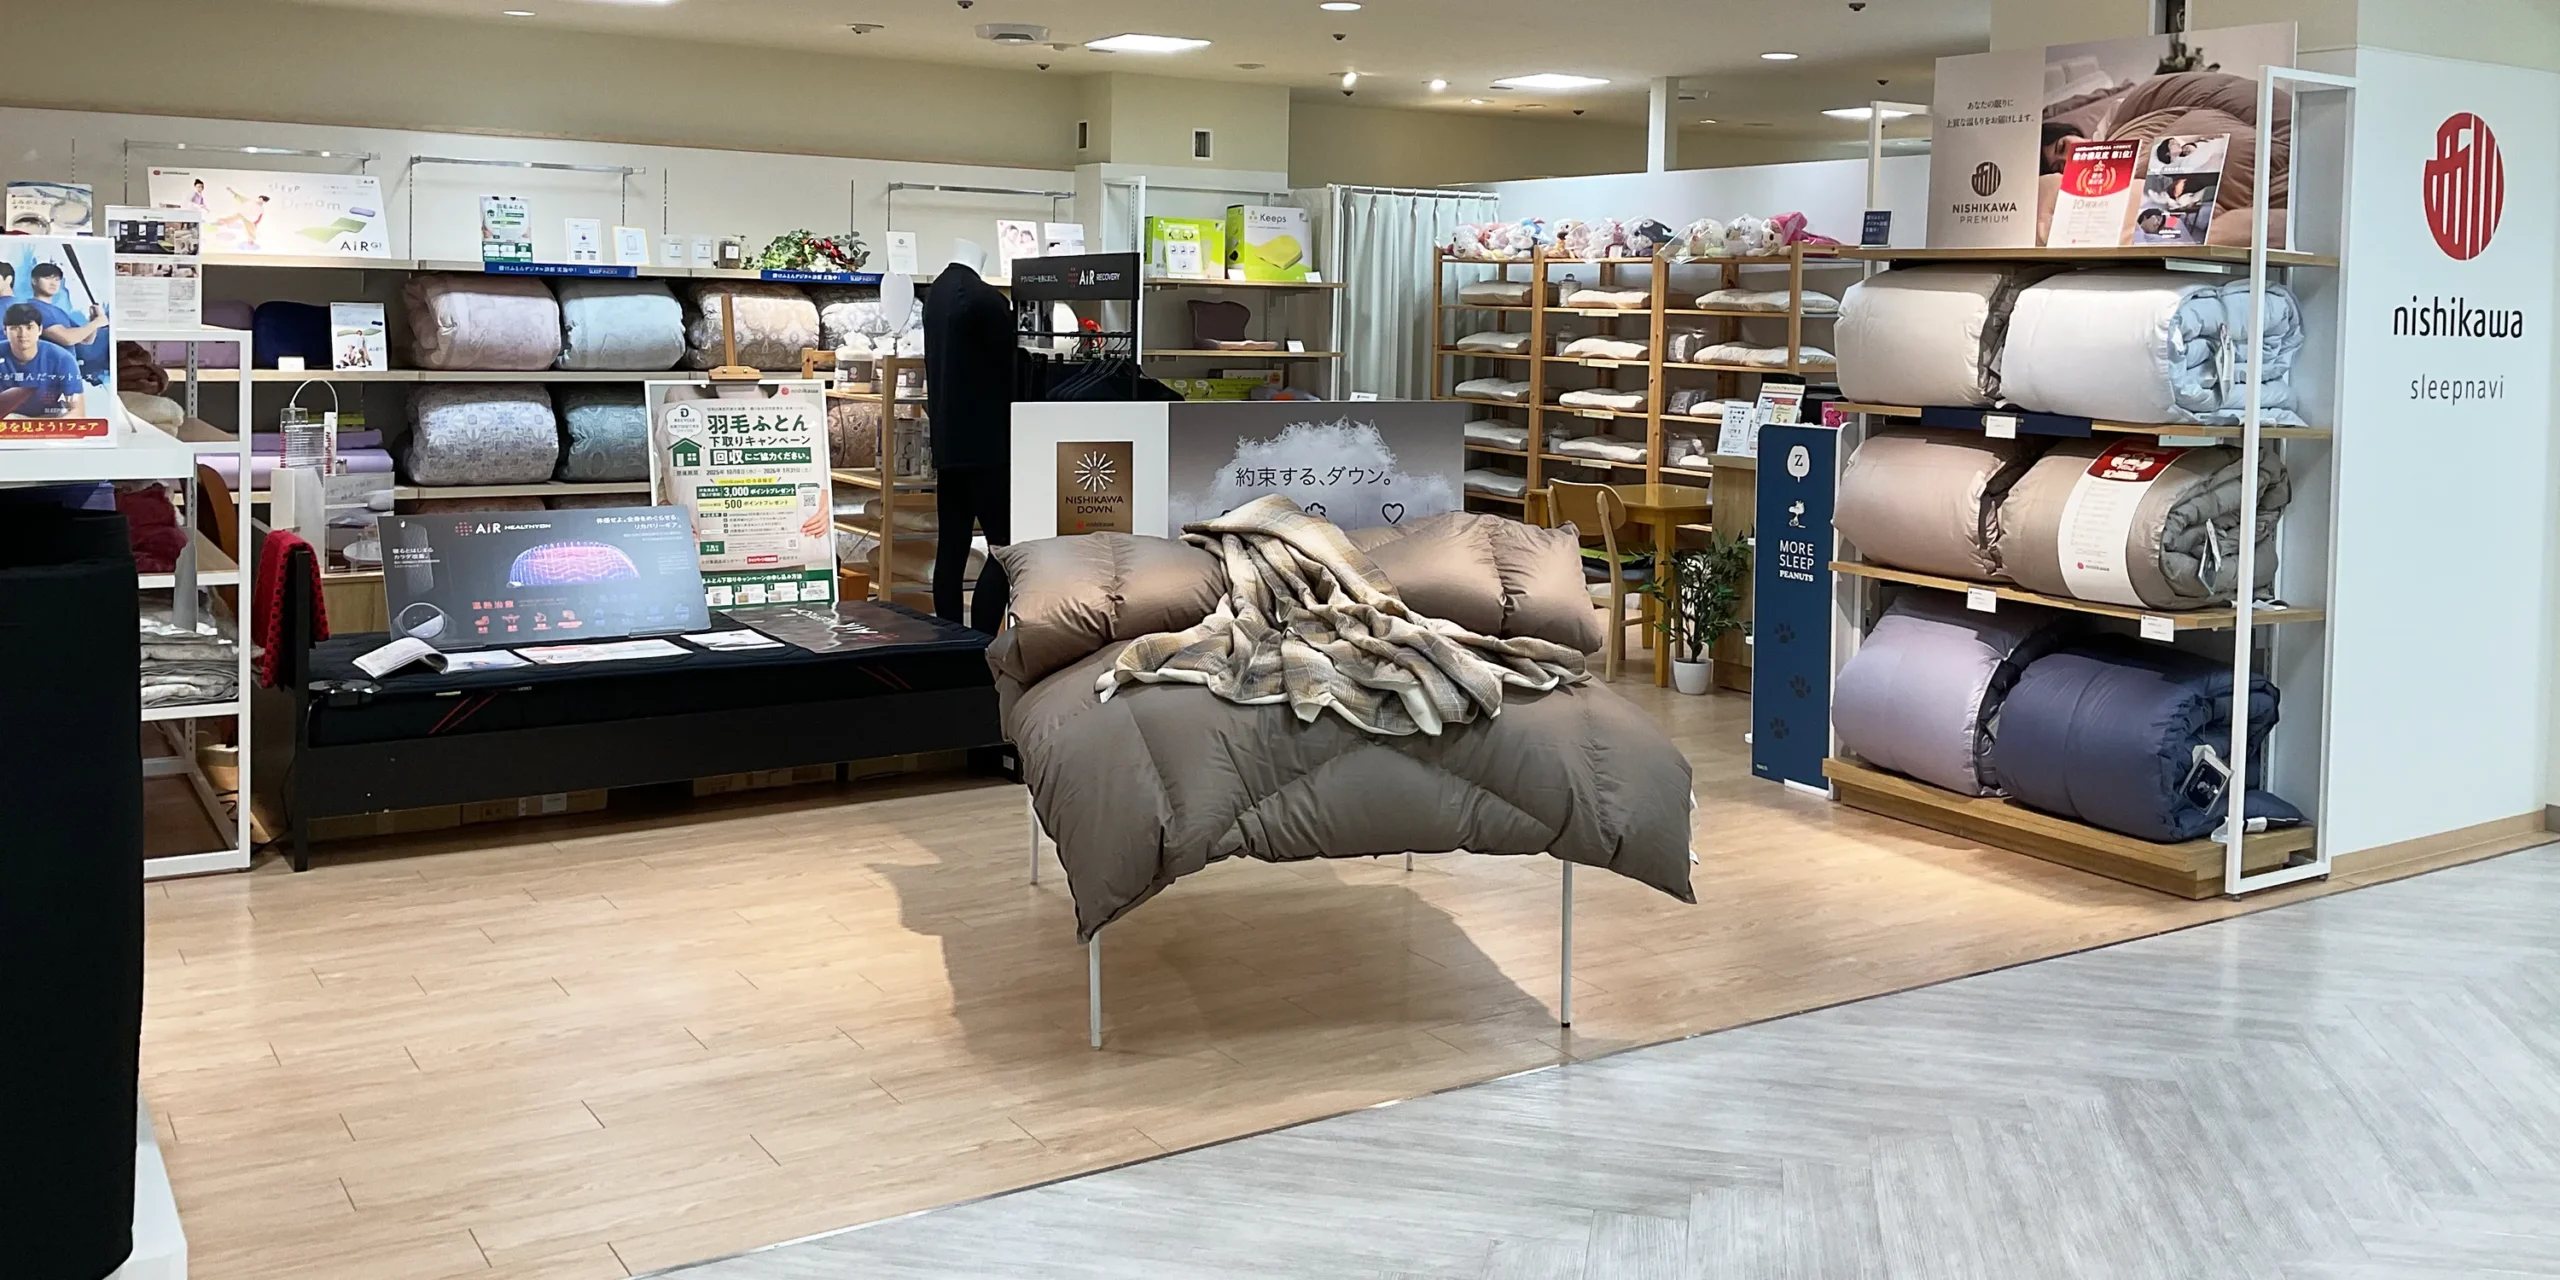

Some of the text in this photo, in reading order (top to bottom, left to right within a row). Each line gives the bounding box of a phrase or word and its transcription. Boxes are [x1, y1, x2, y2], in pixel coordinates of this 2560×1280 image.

[1967, 99, 2014, 110] あなたの眠りに
[1946, 114, 2034, 128] 上質な温もりをお届けします。
[1952, 202, 2018, 214] NISHIKAWA
[1260, 213, 1287, 224] Keeps
[1960, 215, 2009, 224] PREMIUM
[340, 240, 369, 252] AiR
[1079, 269, 1095, 286] AiR
[1096, 272, 1121, 281] RECOVERY
[2393, 294, 2524, 339] nishikawa
[2410, 373, 2504, 406] sleepnavi
[707, 414, 808, 435] 羽毛ふとん
[708, 435, 811, 448] 下取りキャンペーン
[713, 449, 810, 465] 回収にご協力ください。
[1794, 454, 1804, 467] Z
[1235, 465, 1392, 488] 約束する、ダウン。
[723, 486, 795, 498] 3,000 ポイントプレゼント
[724, 499, 743, 509] 500
[1065, 495, 1124, 504] NISHIKAWA
[1077, 505, 1113, 514] DOWN
[475, 522, 502, 534] AiR
[634, 522, 682, 530] リカバリーギア。
[1779, 539, 1814, 557] MORE
[1779, 553, 1815, 570] SLEEP
[1779, 569, 1814, 582] PEANUTS
